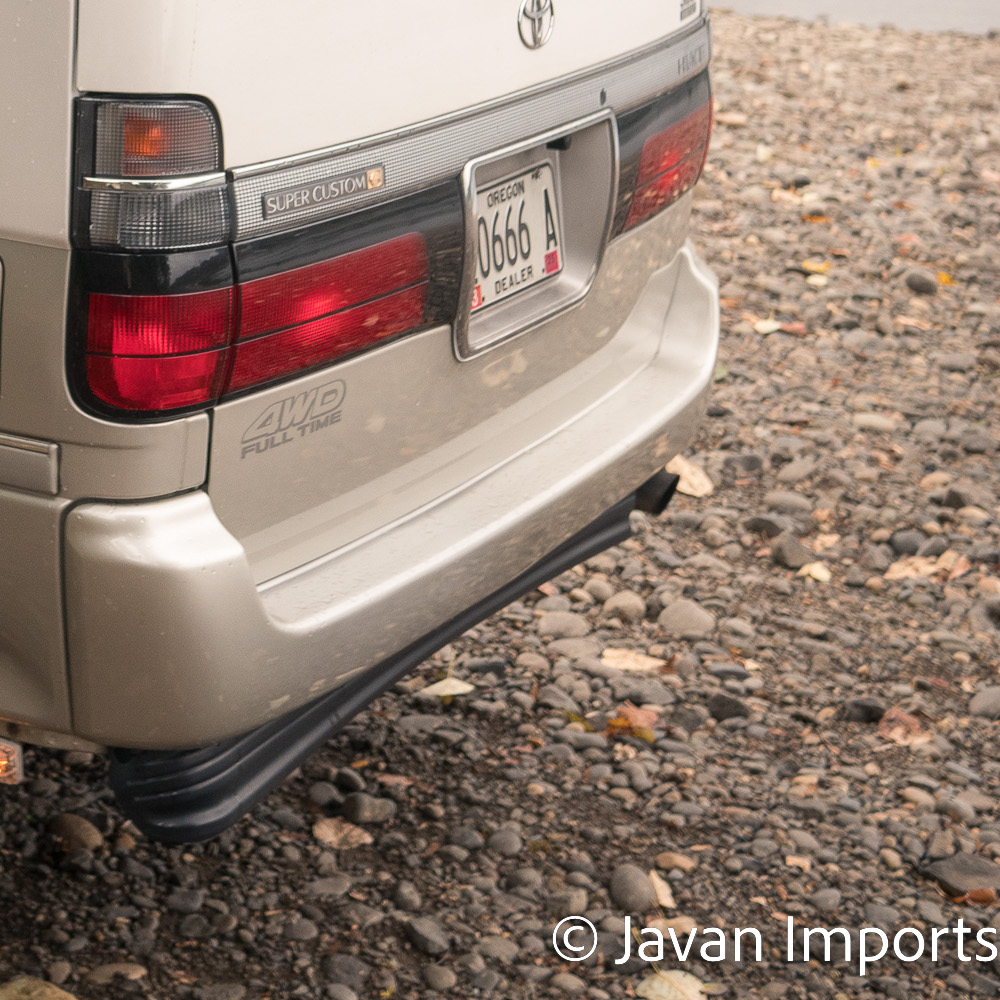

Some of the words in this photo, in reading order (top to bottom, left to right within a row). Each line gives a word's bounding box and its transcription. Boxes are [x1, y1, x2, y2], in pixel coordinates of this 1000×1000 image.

[267, 189, 310, 214] SUPER
[312, 174, 366, 202] CUSTOM
[486, 179, 526, 208] OREGON
[477, 197, 532, 279] 0666
[543, 188, 558, 251] A
[494, 264, 534, 294] DEALER
[241, 379, 346, 445] 4WD
[241, 431, 294, 459] FULL
[296, 409, 342, 437] TIME
